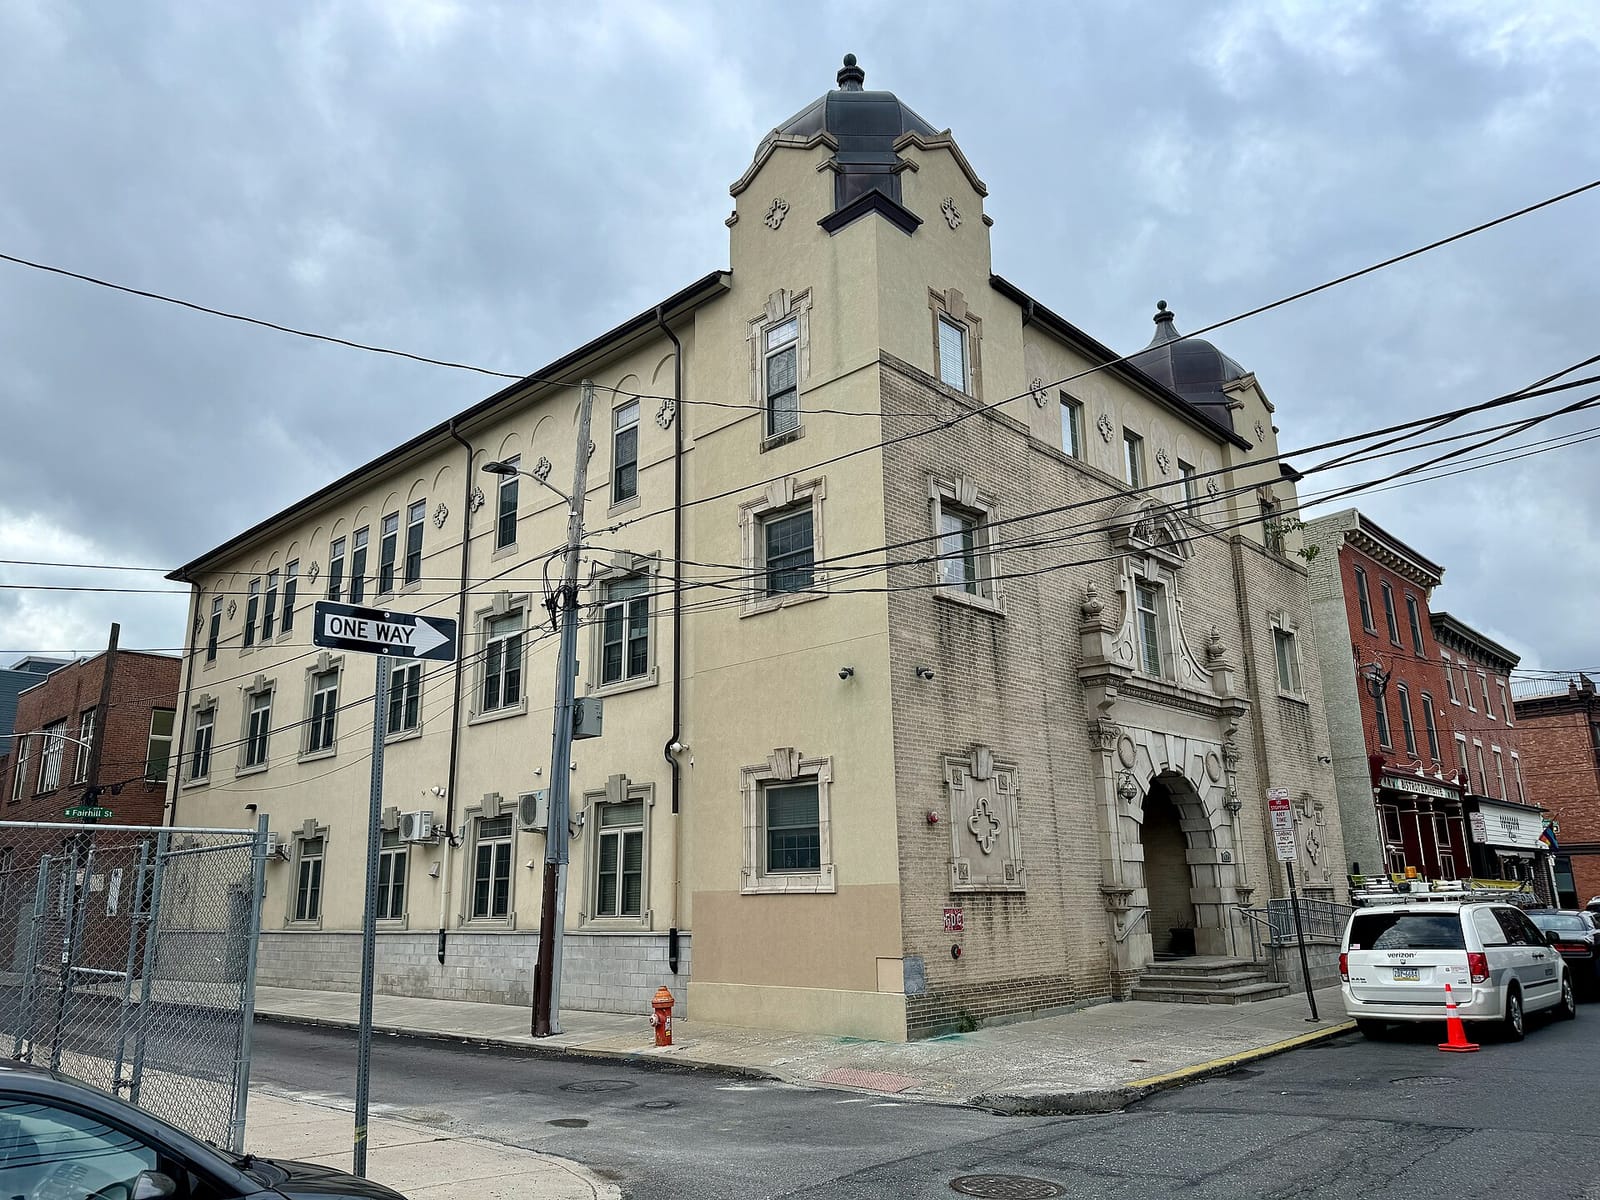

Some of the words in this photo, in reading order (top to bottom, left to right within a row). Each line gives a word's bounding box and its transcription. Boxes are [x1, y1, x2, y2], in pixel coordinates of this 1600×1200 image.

[330, 617, 368, 639] ONE
[376, 623, 414, 644] WAY
[72, 809, 100, 817] Fairhill
